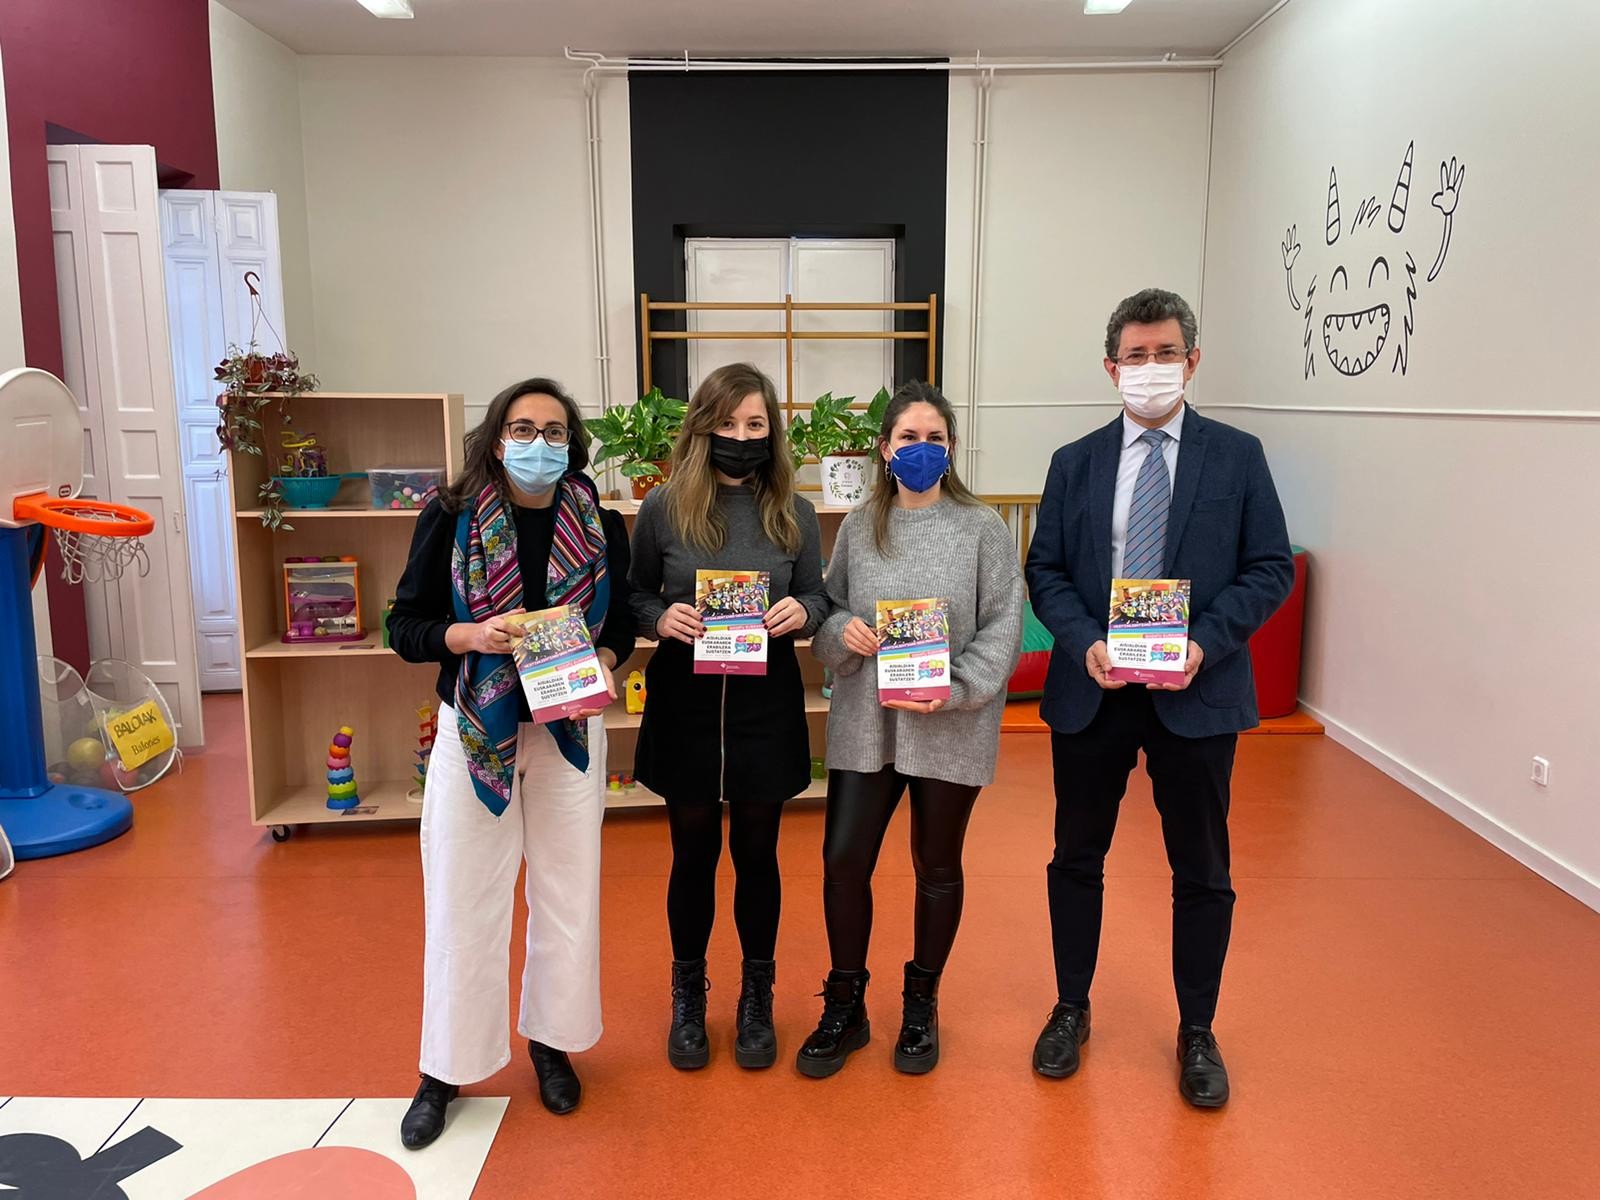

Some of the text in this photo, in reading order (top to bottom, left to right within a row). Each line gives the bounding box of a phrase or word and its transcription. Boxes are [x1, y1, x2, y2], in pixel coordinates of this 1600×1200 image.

[533, 682, 565, 692] EUSKARAREN
[540, 686, 566, 695] ERABILERA
[541, 690, 568, 700] SUSTATZEN
[113, 708, 157, 738] BALOIAK
[131, 735, 161, 756] Balones
